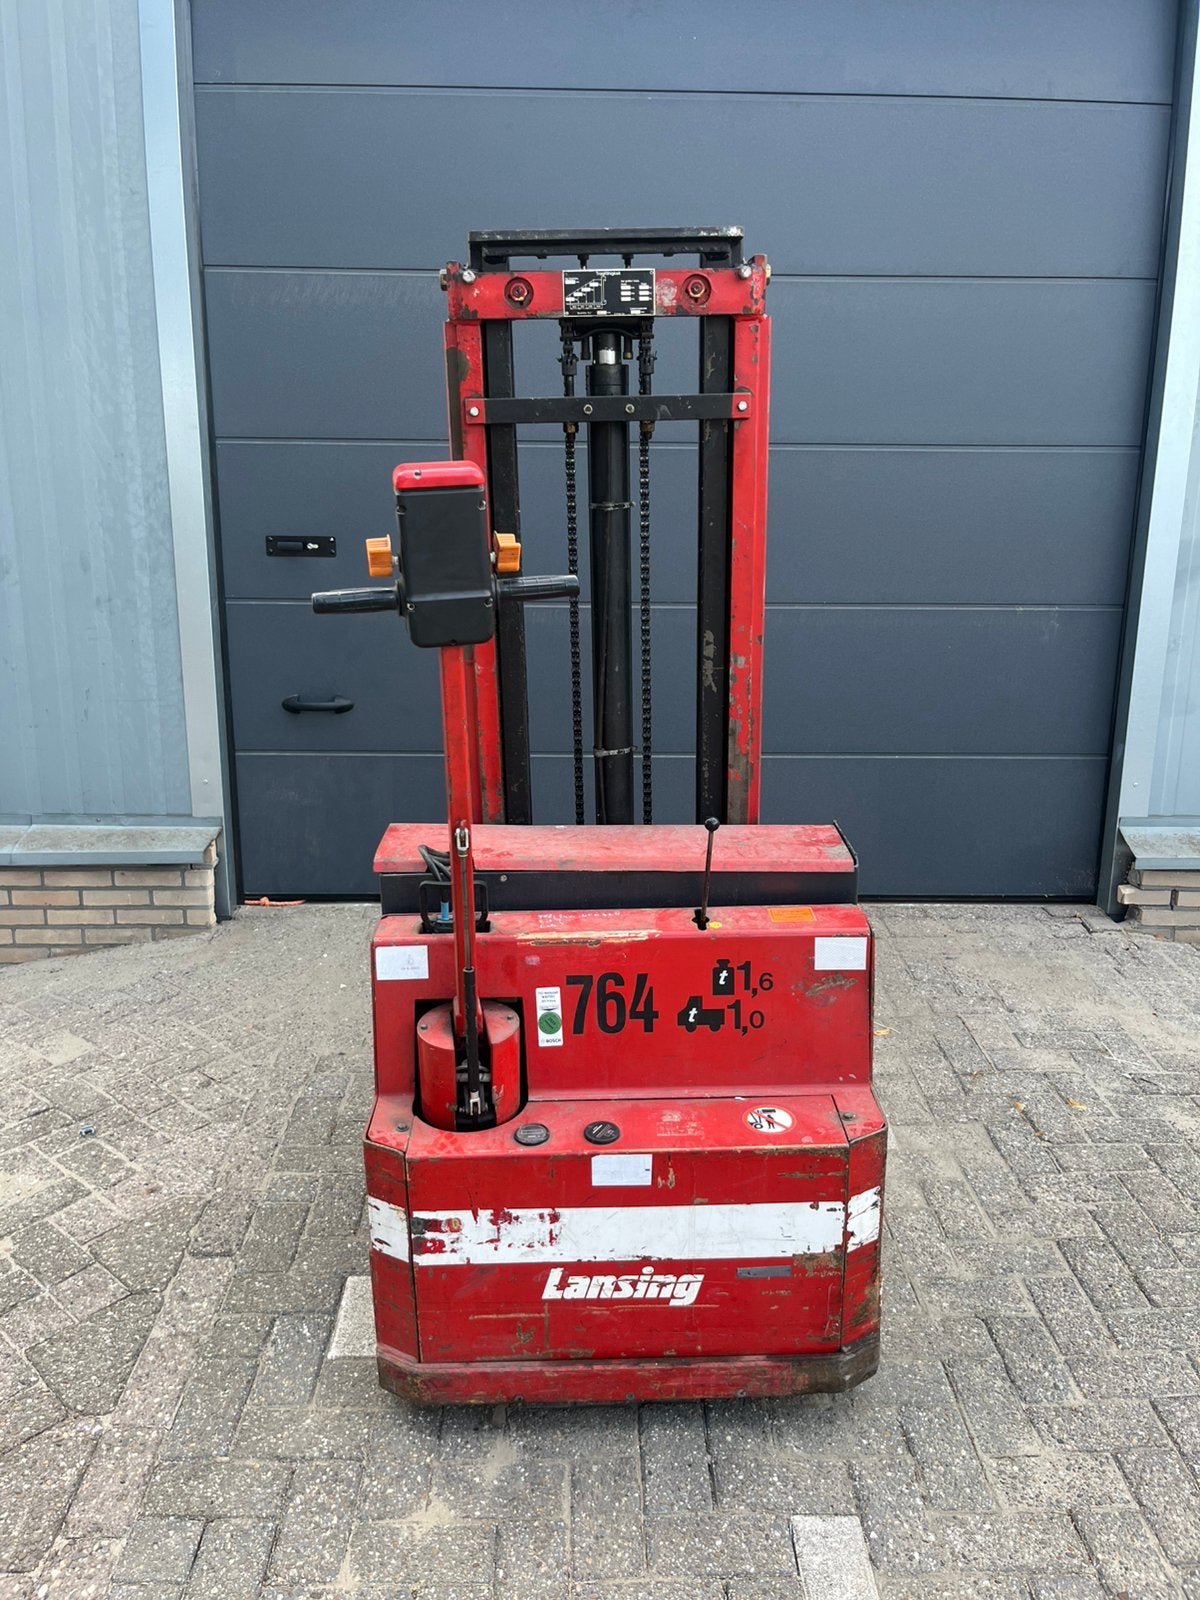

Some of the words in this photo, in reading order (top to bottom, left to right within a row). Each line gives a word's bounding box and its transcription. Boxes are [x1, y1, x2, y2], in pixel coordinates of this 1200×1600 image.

[736, 960, 774, 998] 1,6
[565, 971, 660, 1035] 764
[726, 999, 765, 1037] 1,0
[541, 1265, 705, 1307] Lansing
